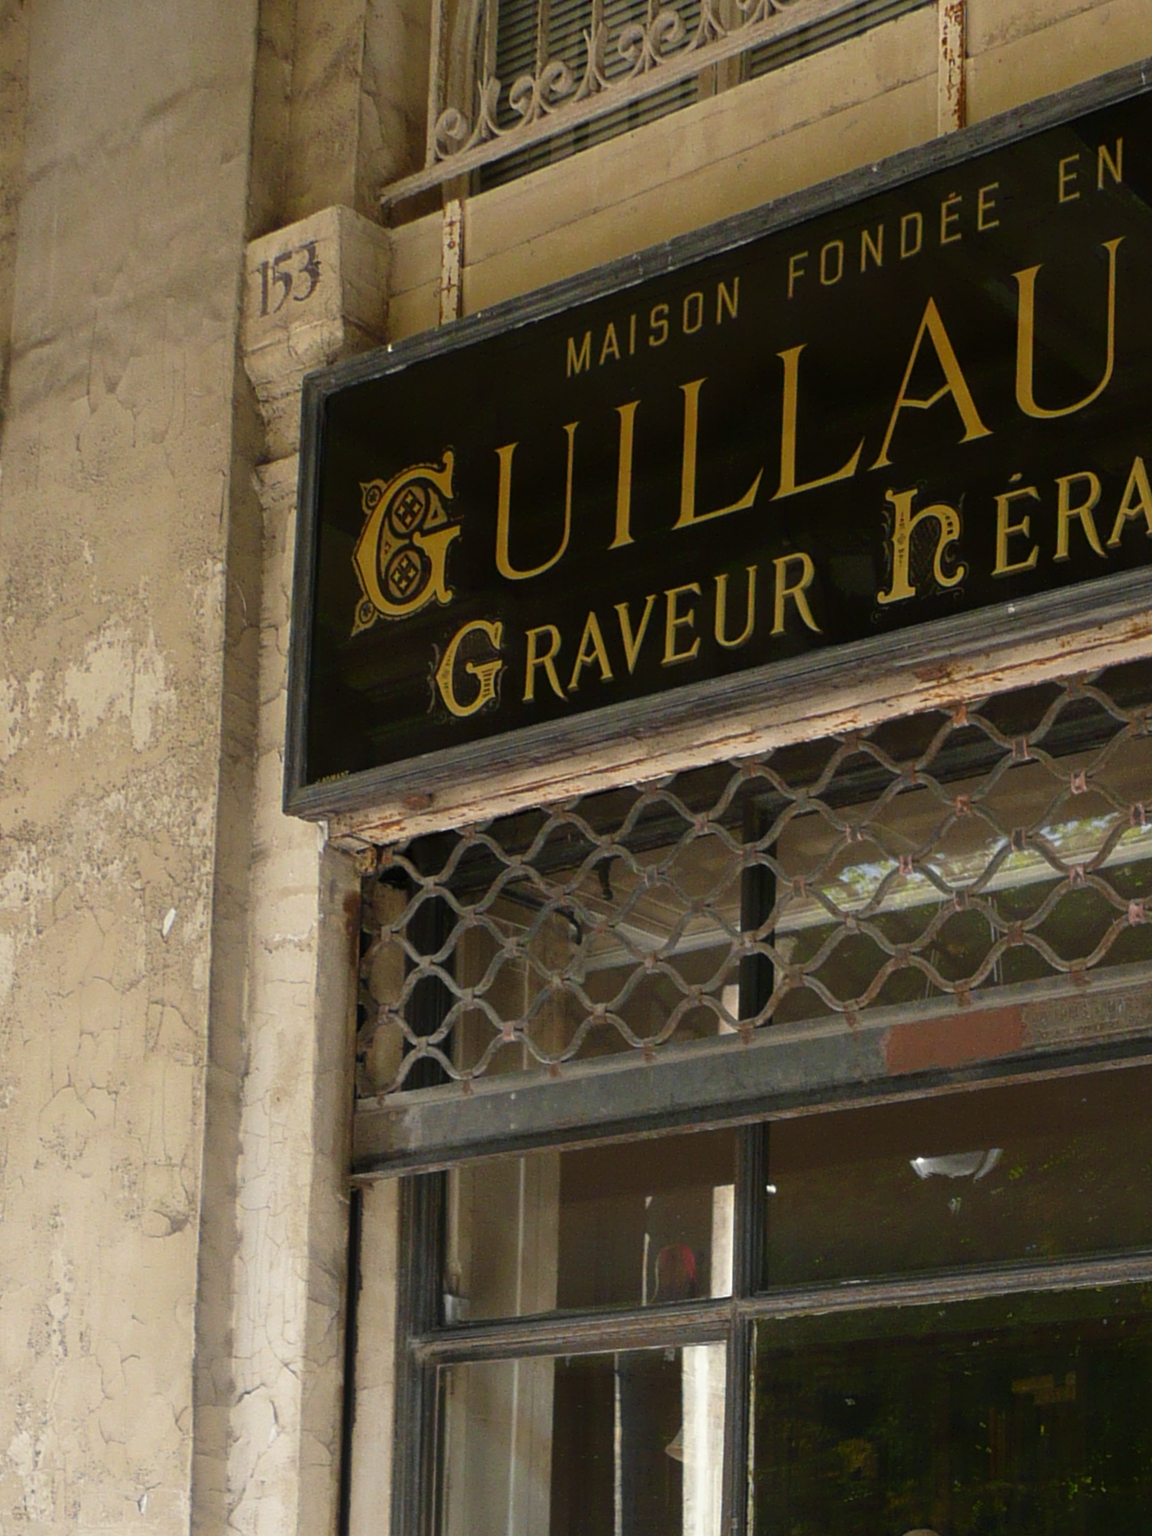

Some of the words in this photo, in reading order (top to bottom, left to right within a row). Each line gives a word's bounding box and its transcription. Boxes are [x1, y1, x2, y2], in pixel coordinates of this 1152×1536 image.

[259, 239, 321, 318] 153
[566, 277, 740, 377] MAISON
[788, 182, 1000, 298] FONDÉE
[1059, 138, 1124, 203] EN
[430, 551, 823, 718] GRAVEUR
